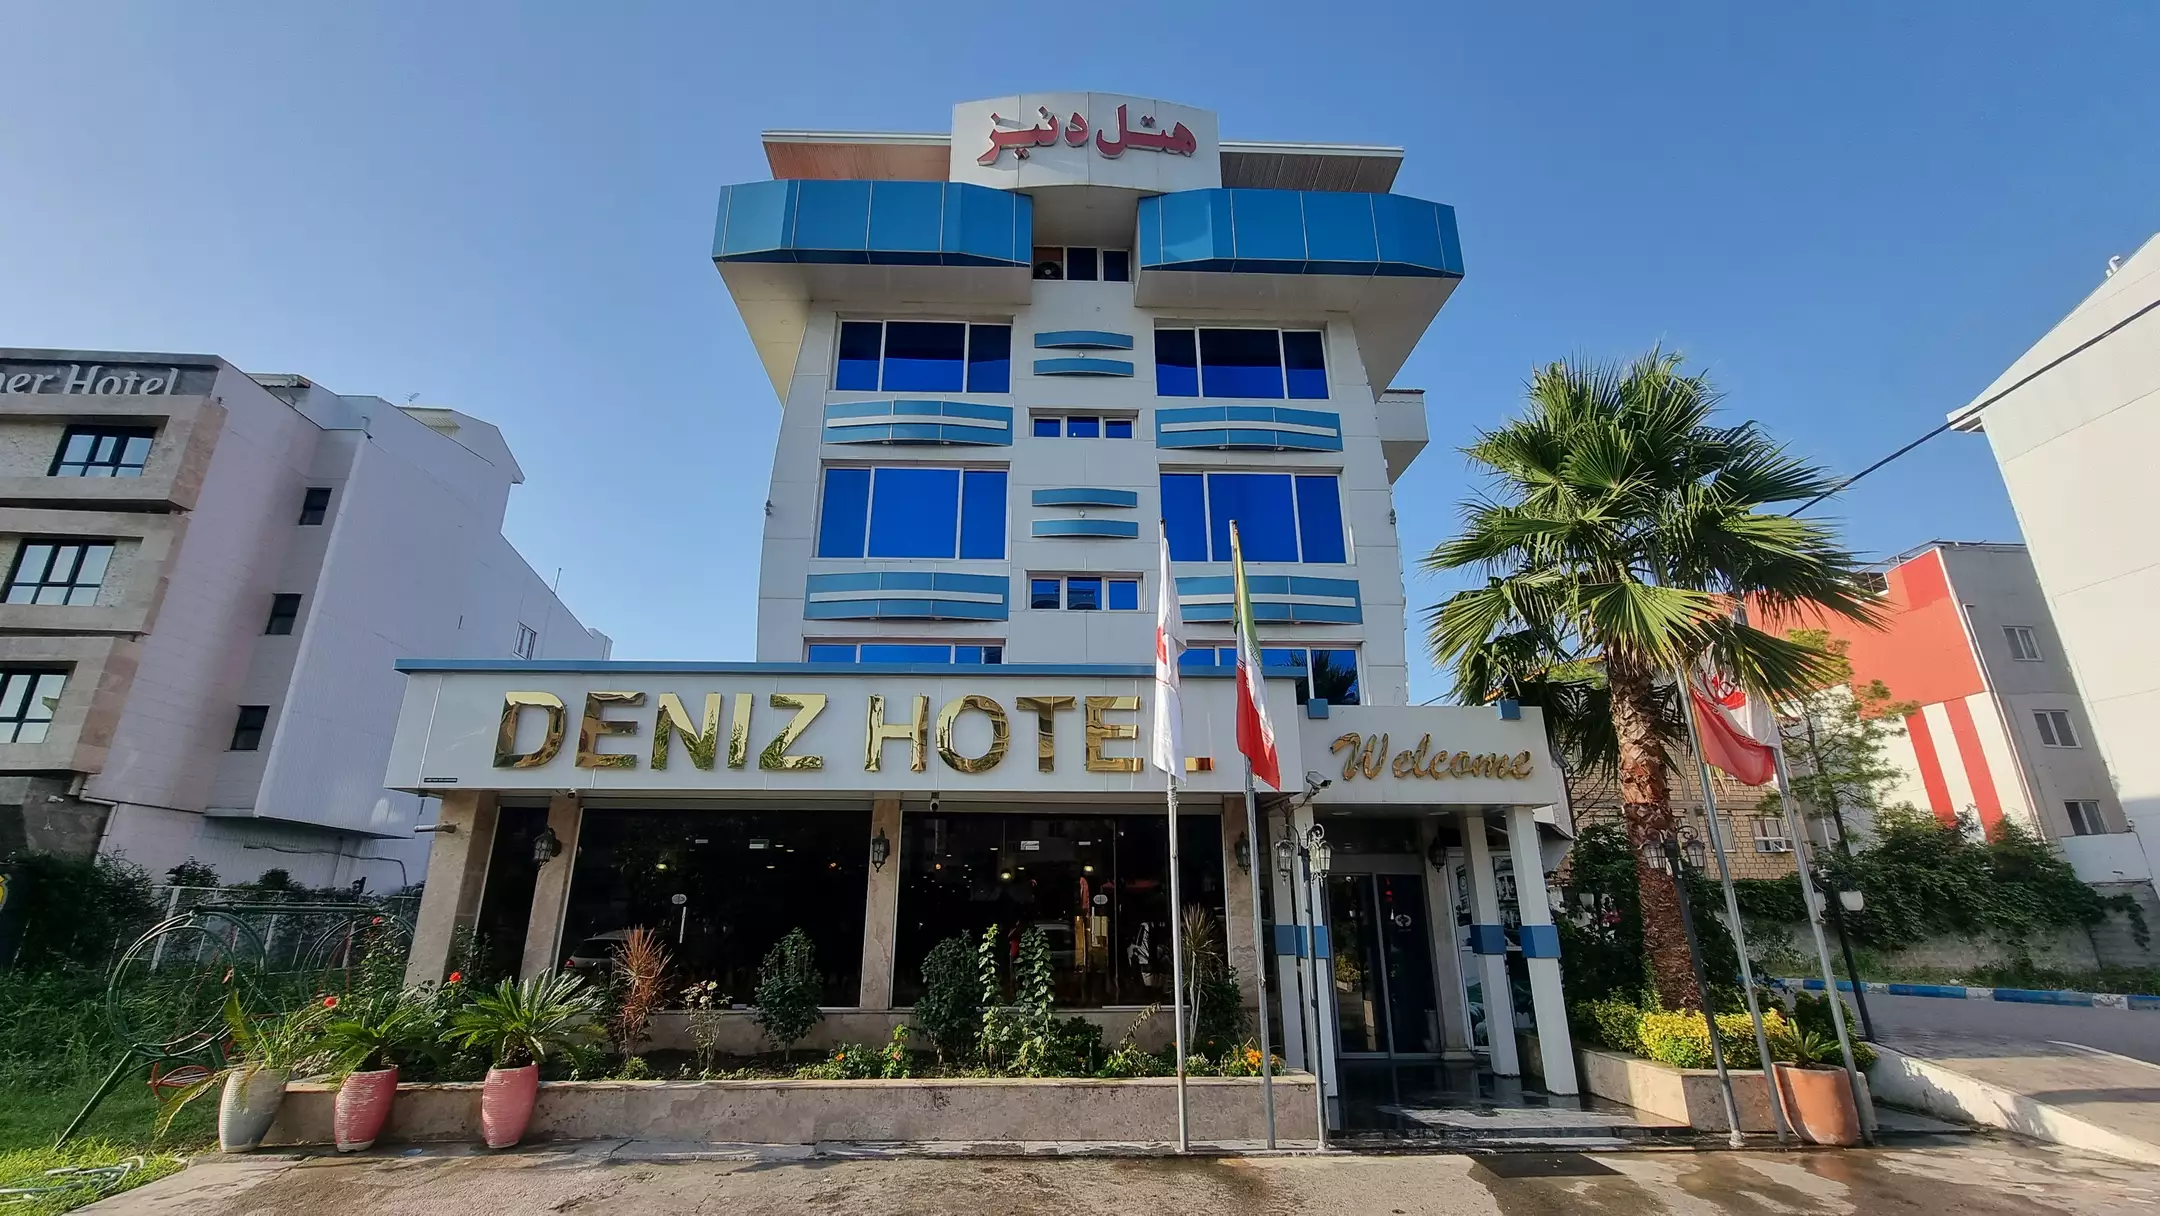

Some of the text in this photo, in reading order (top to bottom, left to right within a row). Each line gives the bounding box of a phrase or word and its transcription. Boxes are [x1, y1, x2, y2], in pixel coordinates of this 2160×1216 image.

[976, 103, 1197, 167] هتل دنیز
[0, 364, 181, 396] er Hotel
[492, 691, 1215, 774] DENIZ HOTE
[1330, 732, 1534, 781] Welcome
